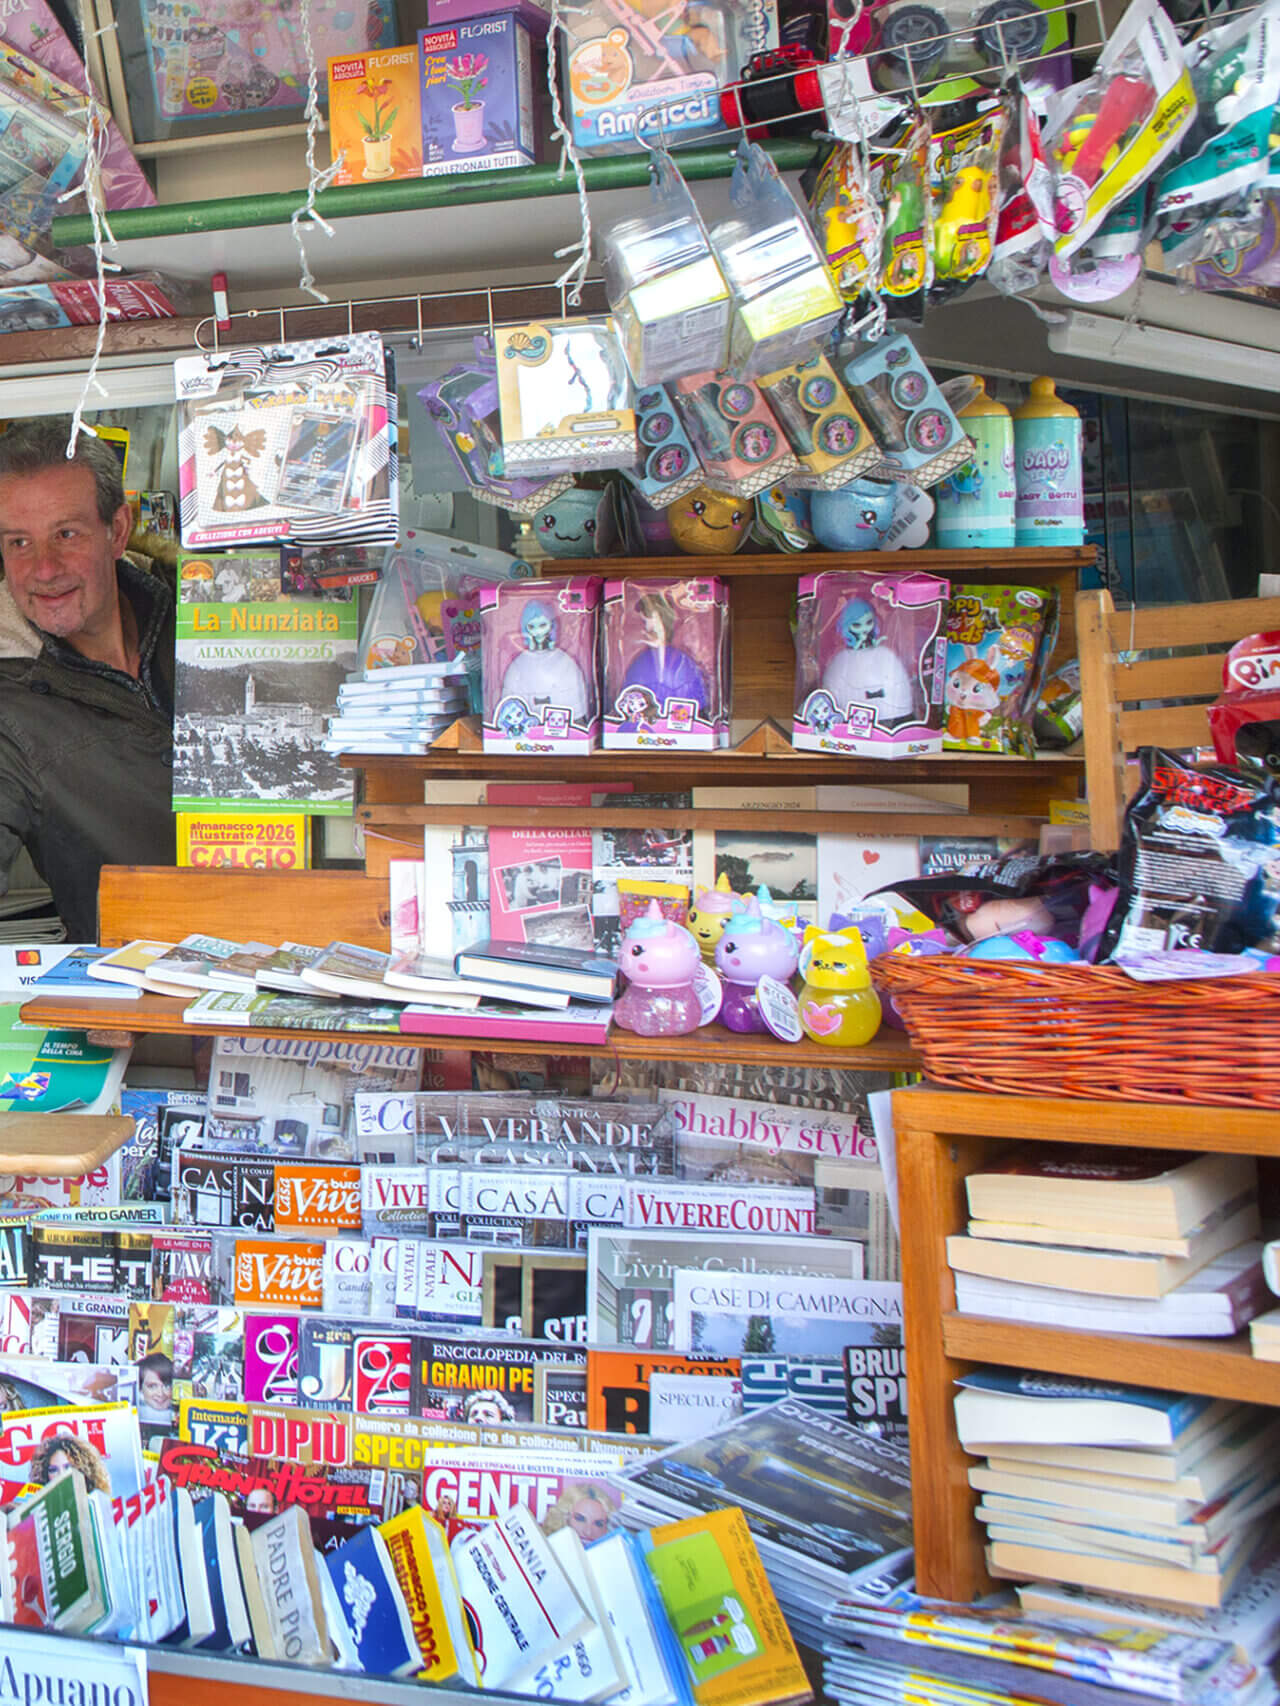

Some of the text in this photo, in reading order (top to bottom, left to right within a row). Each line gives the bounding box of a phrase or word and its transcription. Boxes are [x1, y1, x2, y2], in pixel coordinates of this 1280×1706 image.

[461, 20, 507, 39] FLORIST
[369, 52, 415, 68] FLORIST
[192, 607, 340, 632] La Nunziata
[197, 642, 334, 660] ALMANACCO 2026
[189, 821, 255, 831] almanacco
[189, 823, 297, 841] illustrato 2026
[511, 830, 547, 840] DELLA
[190, 847, 297, 868] CALCIO
[40, 1047, 84, 1057] DELLA CINA
[51, 1042, 79, 1050] TEMPO
[239, 1036, 418, 1073] Campagna
[480, 1116, 654, 1149] VERANDE
[673, 1100, 879, 1159] Shabby style
[276, 1176, 291, 1217] Casa
[476, 1186, 567, 1218] CASA
[74, 1210, 108, 1222] retro
[109, 1208, 157, 1221] GAMER
[237, 1252, 253, 1292] Casa
[402, 1243, 415, 1292] NATALE
[425, 1248, 437, 1299] NATALE
[71, 1301, 127, 1316] LE GRANDI
[690, 1286, 903, 1319] CASE DI CAMPAGNA
[433, 1344, 539, 1364] ENCICLOPEDIA
[431, 1362, 508, 1392] GRANDI
[252, 1413, 347, 1467] DIPIÙ
[355, 1416, 478, 1443] Numero da collezione
[425, 1468, 559, 1525] GENTE
[52, 1509, 77, 1580] SERGIO
[503, 1514, 549, 1586] URANIA
[266, 1524, 303, 1660] PADRE PIO
[468, 1545, 530, 1653] STAZIONE CENTRALE
